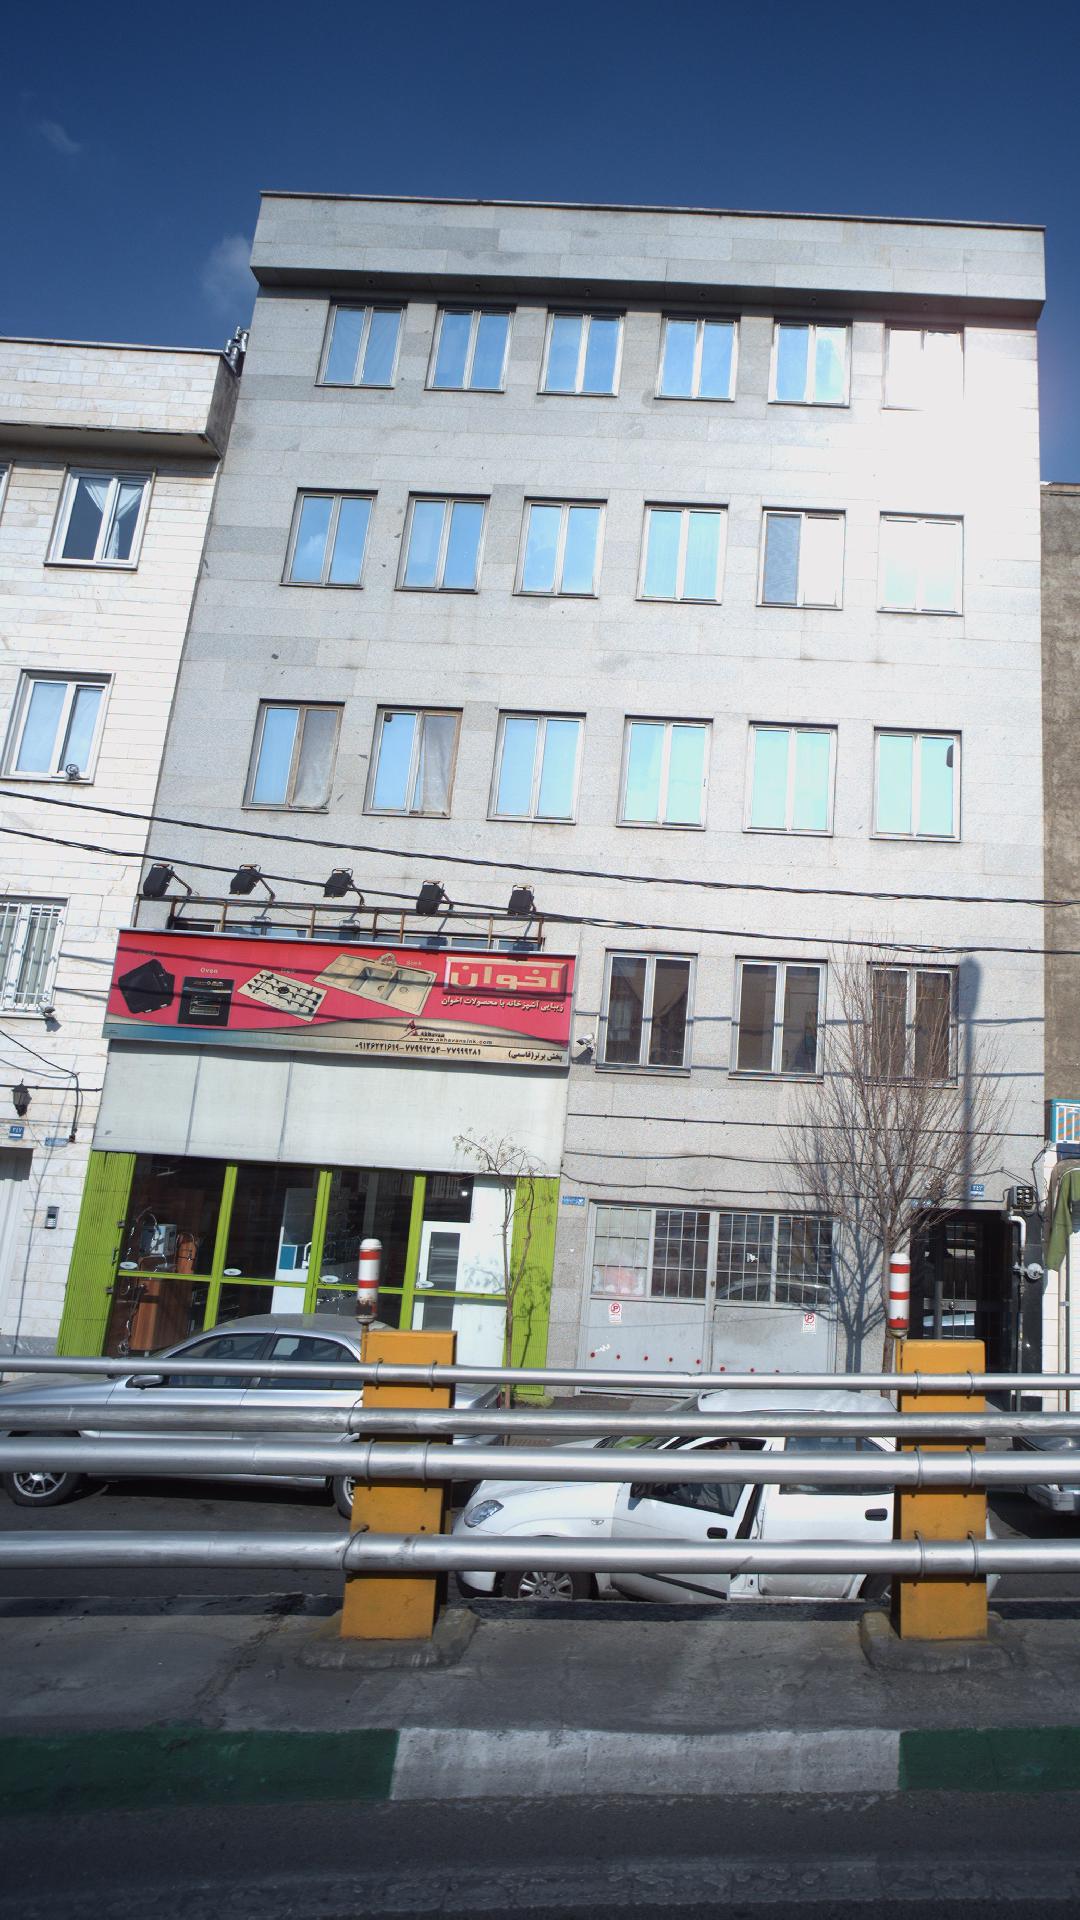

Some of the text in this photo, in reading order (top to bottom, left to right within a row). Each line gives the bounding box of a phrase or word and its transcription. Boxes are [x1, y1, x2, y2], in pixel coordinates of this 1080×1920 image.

[450, 965, 560, 991] اخوان
[441, 995, 463, 1006] اخوان
[463, 997, 498, 1008] محصولات
[507, 999, 539, 1011] آشپزخانه
[541, 1002, 564, 1012] زیبایی
[546, 1052, 563, 1062] پخش
